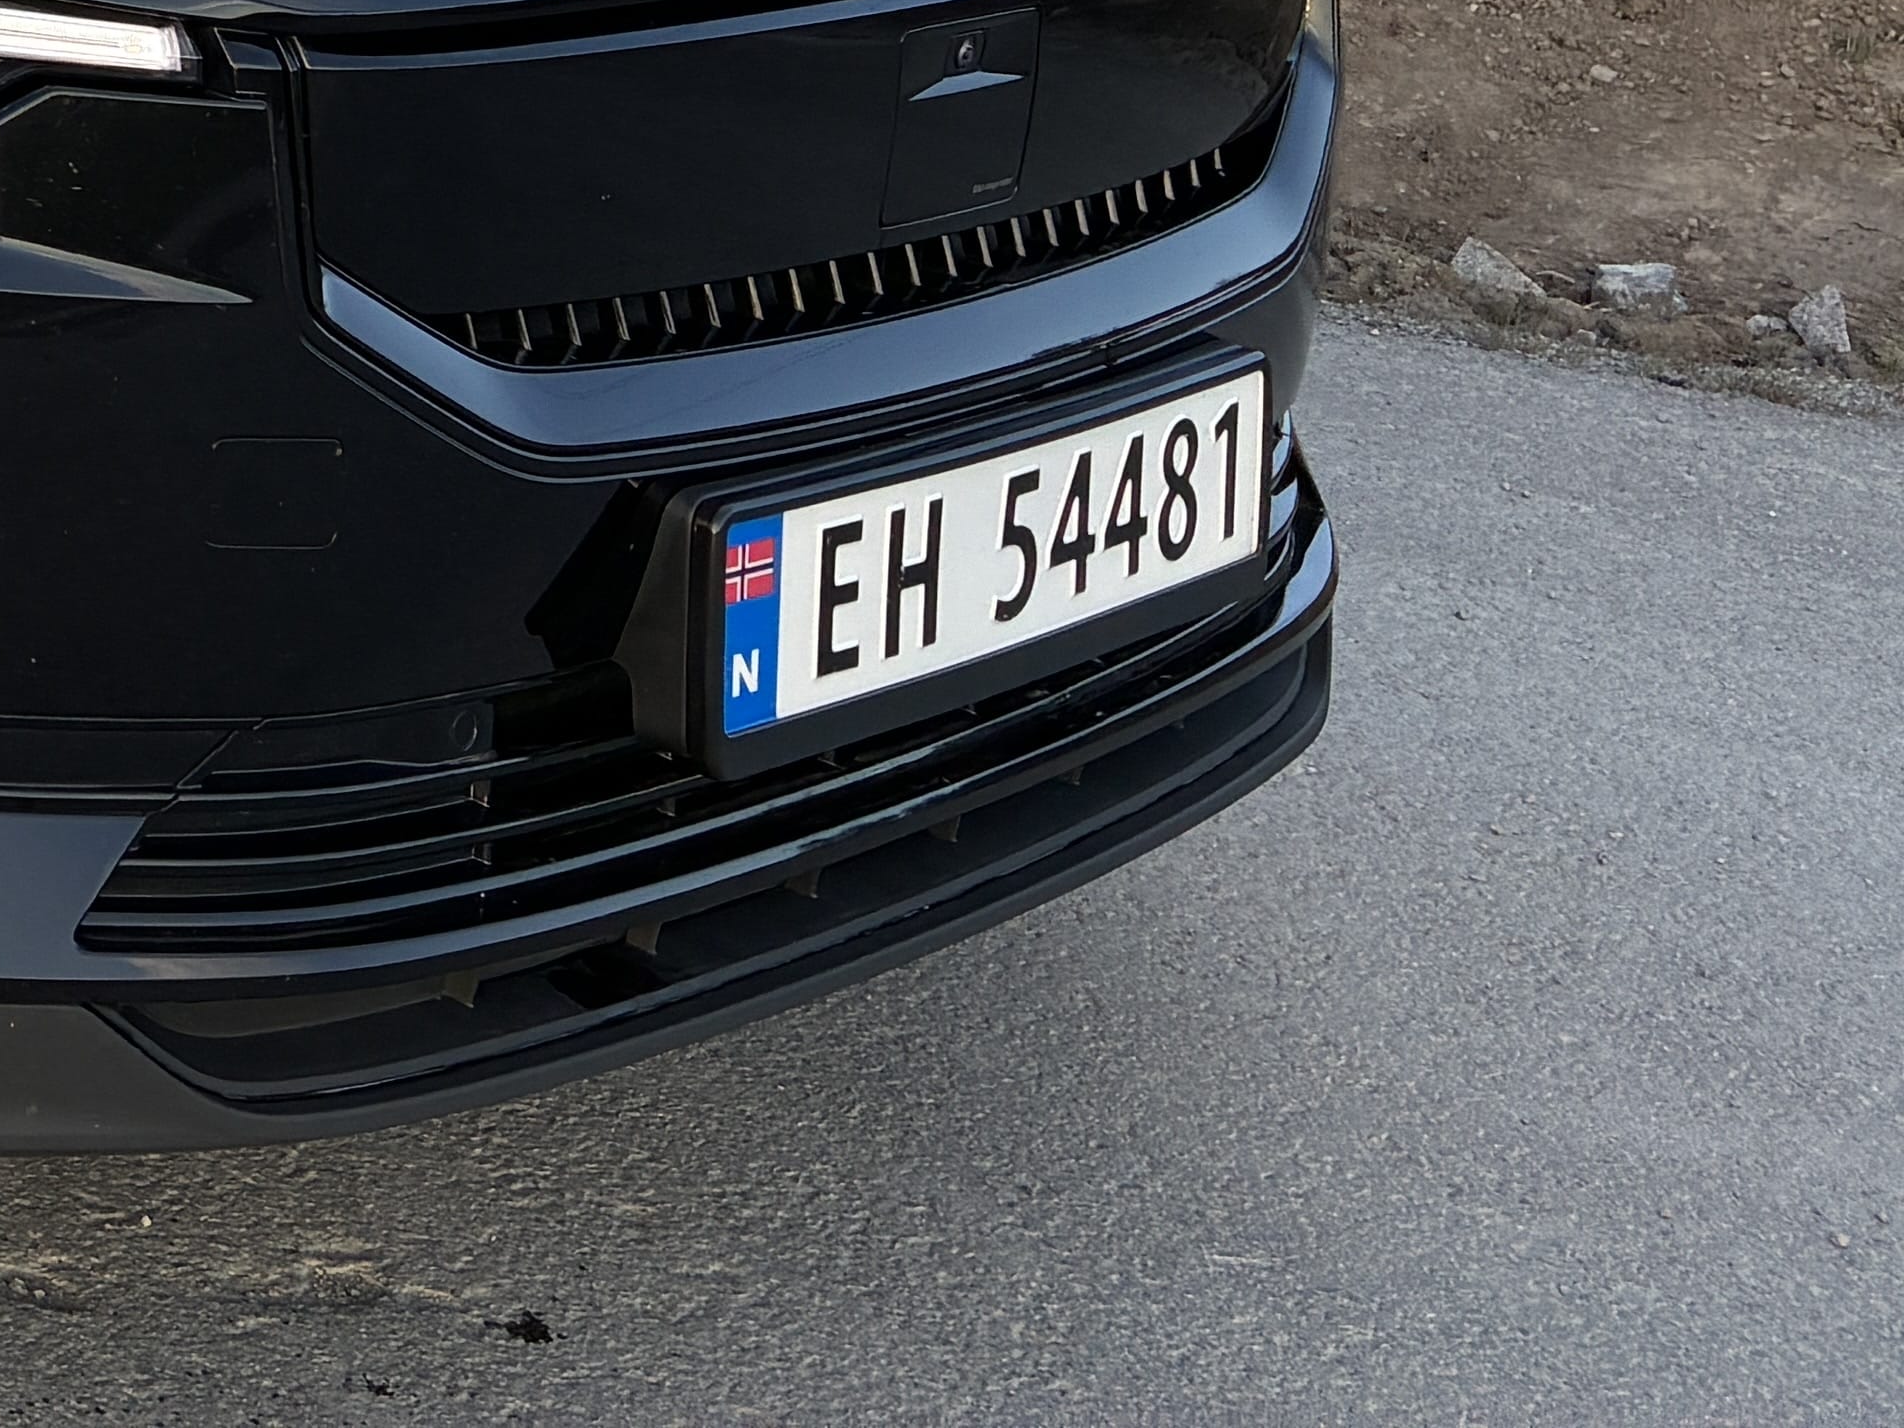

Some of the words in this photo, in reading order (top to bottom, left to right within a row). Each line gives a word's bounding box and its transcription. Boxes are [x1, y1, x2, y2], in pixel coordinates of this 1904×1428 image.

[815, 496, 944, 679] EH
[993, 398, 1240, 622] 54481
[730, 647, 760, 699] N
